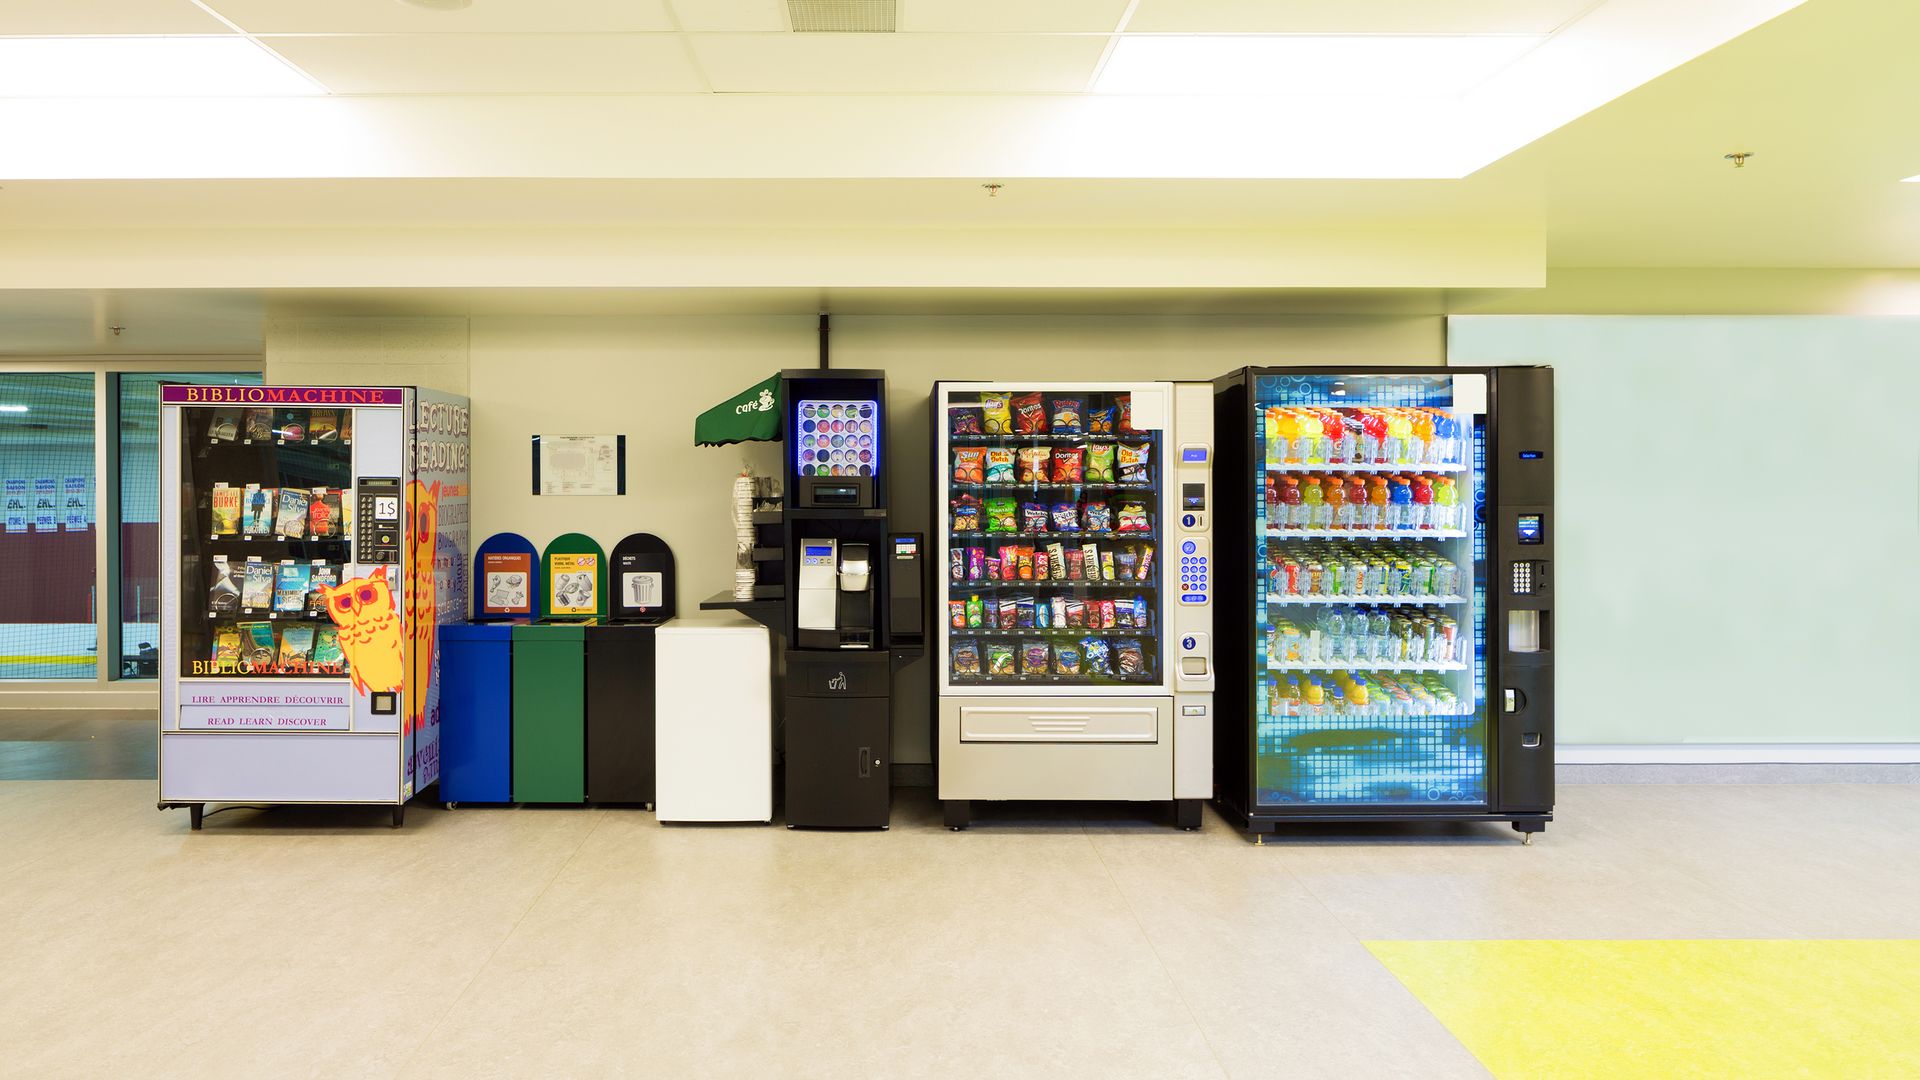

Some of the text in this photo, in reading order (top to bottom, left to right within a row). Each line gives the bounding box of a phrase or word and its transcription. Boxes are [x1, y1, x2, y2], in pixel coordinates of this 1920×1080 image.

[187, 387, 385, 404] BIBLIOMACHINE
[736, 398, 759, 416] café
[213, 497, 239, 508] BURKE
[282, 494, 308, 507] Daniel
[379, 498, 396, 515] 1$
[1186, 516, 1191, 525] 1
[246, 565, 272, 575] Daniel
[192, 660, 344, 676] BIBLIOMACHINE
[192, 694, 344, 704] LIRE APPRENDRE DÉCOUVRIR
[207, 717, 328, 726] READ LEARN DISCOVER
